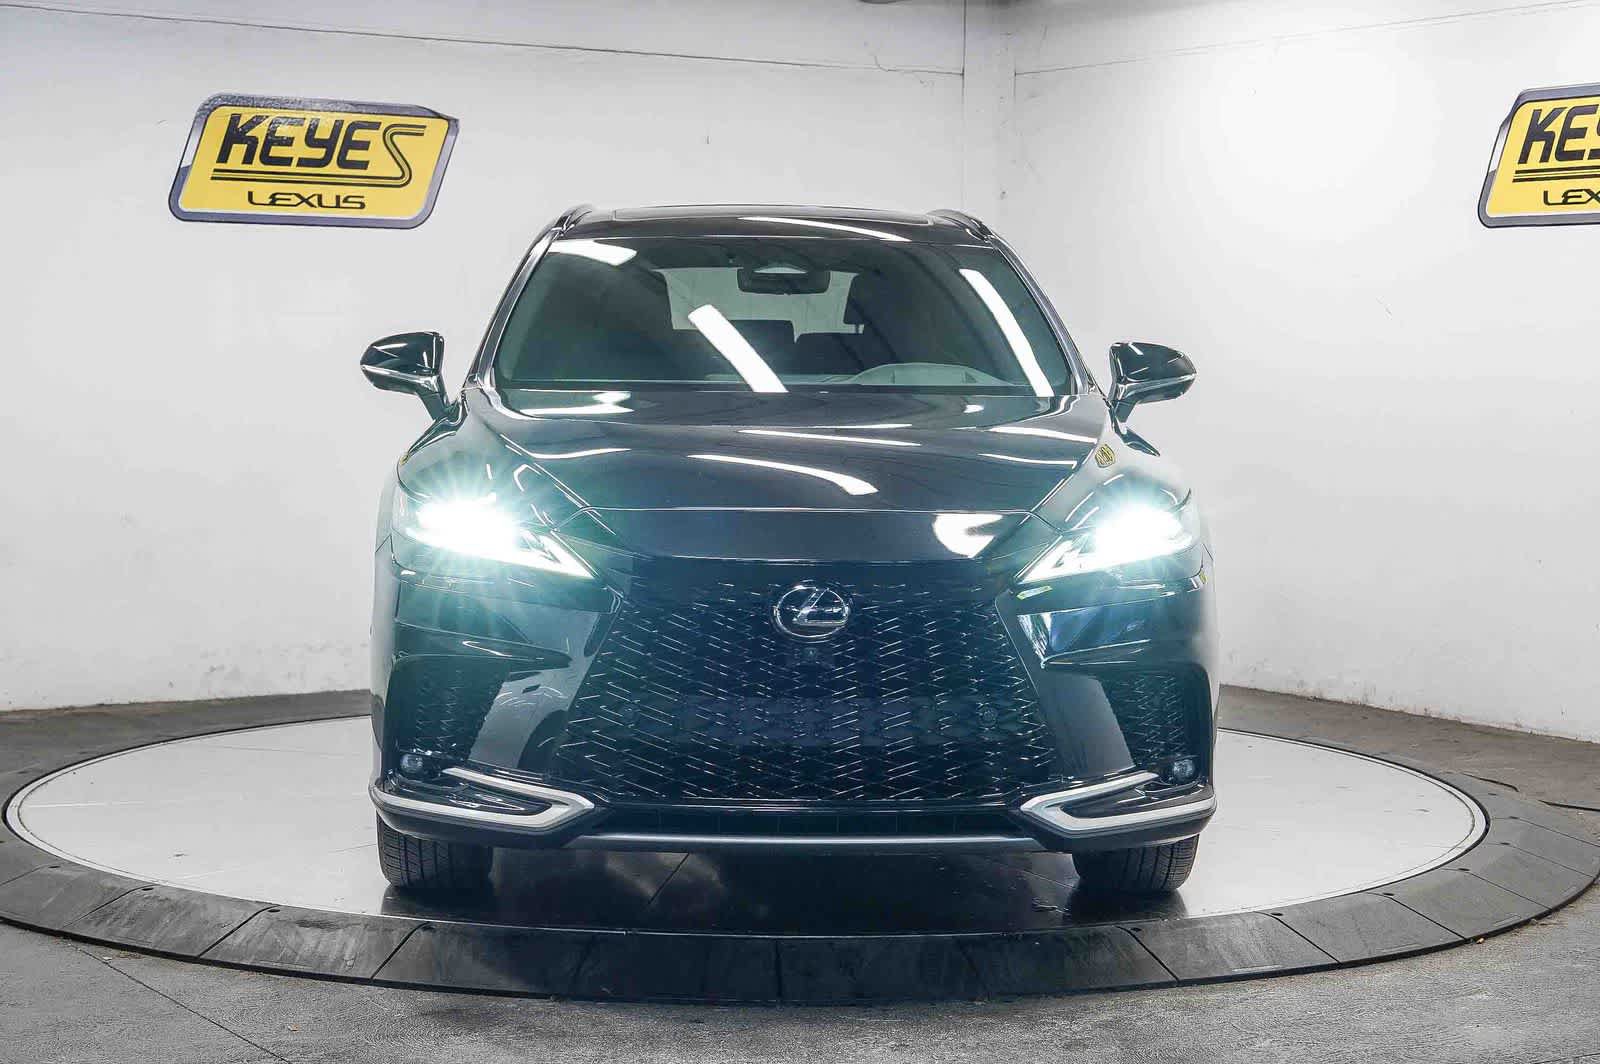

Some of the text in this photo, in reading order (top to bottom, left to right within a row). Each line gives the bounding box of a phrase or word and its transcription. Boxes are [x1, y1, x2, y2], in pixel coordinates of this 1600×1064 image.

[213, 113, 427, 185] KEYES
[1517, 104, 1600, 165] KE
[247, 191, 366, 210] LEXUS
